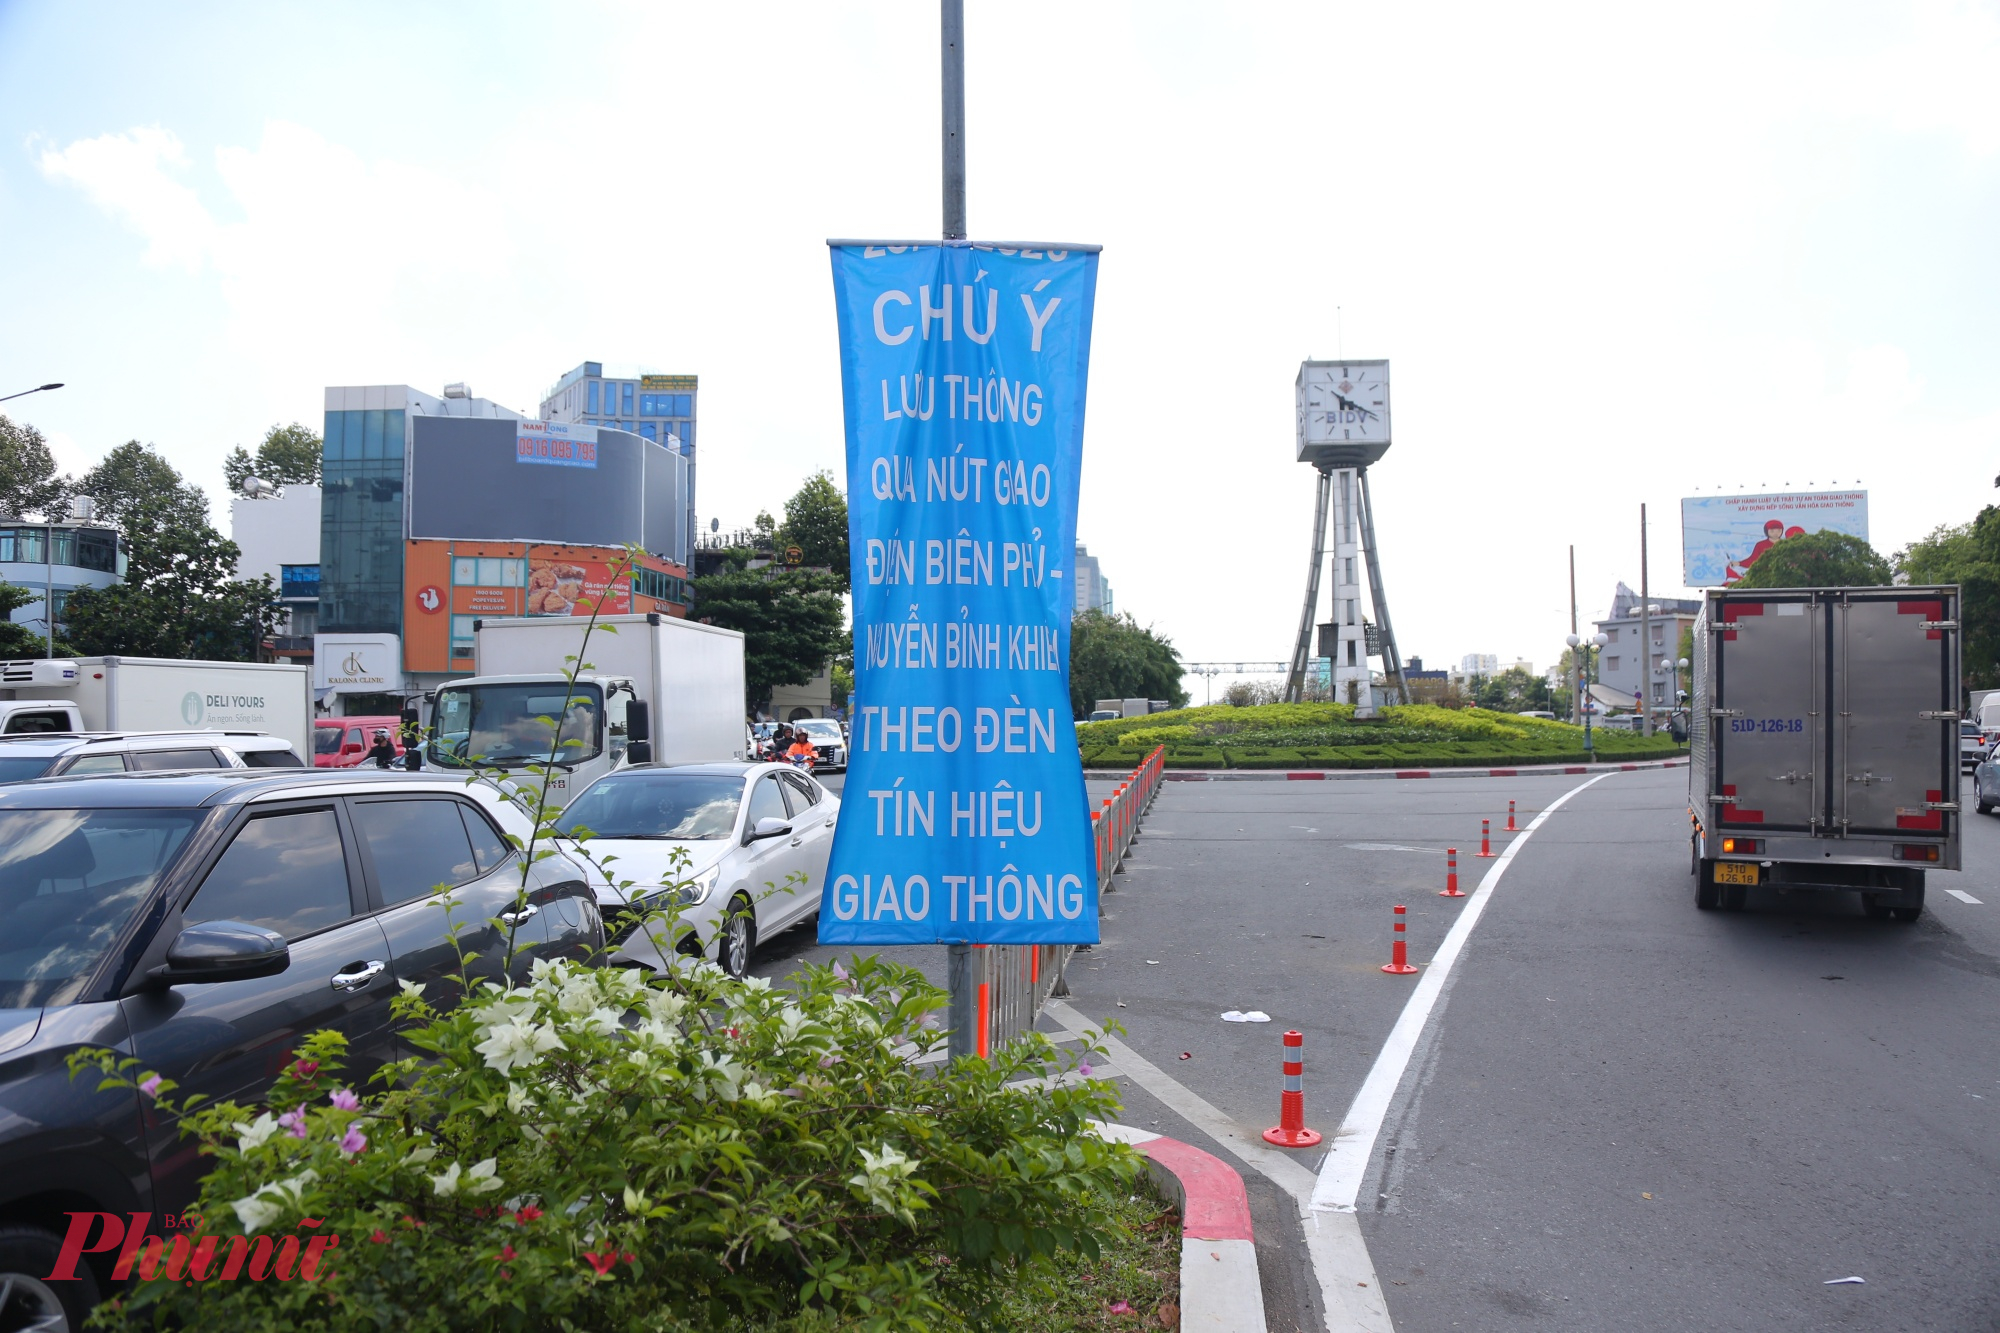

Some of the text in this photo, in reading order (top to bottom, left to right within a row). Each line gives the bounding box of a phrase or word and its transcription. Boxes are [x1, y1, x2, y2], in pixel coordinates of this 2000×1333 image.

[873, 269, 1062, 352] CHÚ Ý
[943, 367, 1043, 426] THÔNG
[1326, 411, 1368, 423] BIDV
[518, 438, 596, 460] 0916 095 795
[523, 423, 542, 431] NAM
[871, 443, 1051, 507] QUA NÚT GIAO
[1835, 500, 1854, 508] THÔNG
[926, 527, 993, 586] BIÊN
[1003, 527, 1045, 589] PHỦ
[946, 605, 1000, 670] BỈNH
[206, 695, 265, 708] DELI YOURS
[862, 694, 1056, 753] THEO ĐÈN
[868, 777, 1042, 849] TÍN HIỆU
[832, 864, 1083, 922] GIAO THÔNG
[1720, 873, 1754, 884] 126.18
[1727, 864, 1746, 874] 51D
